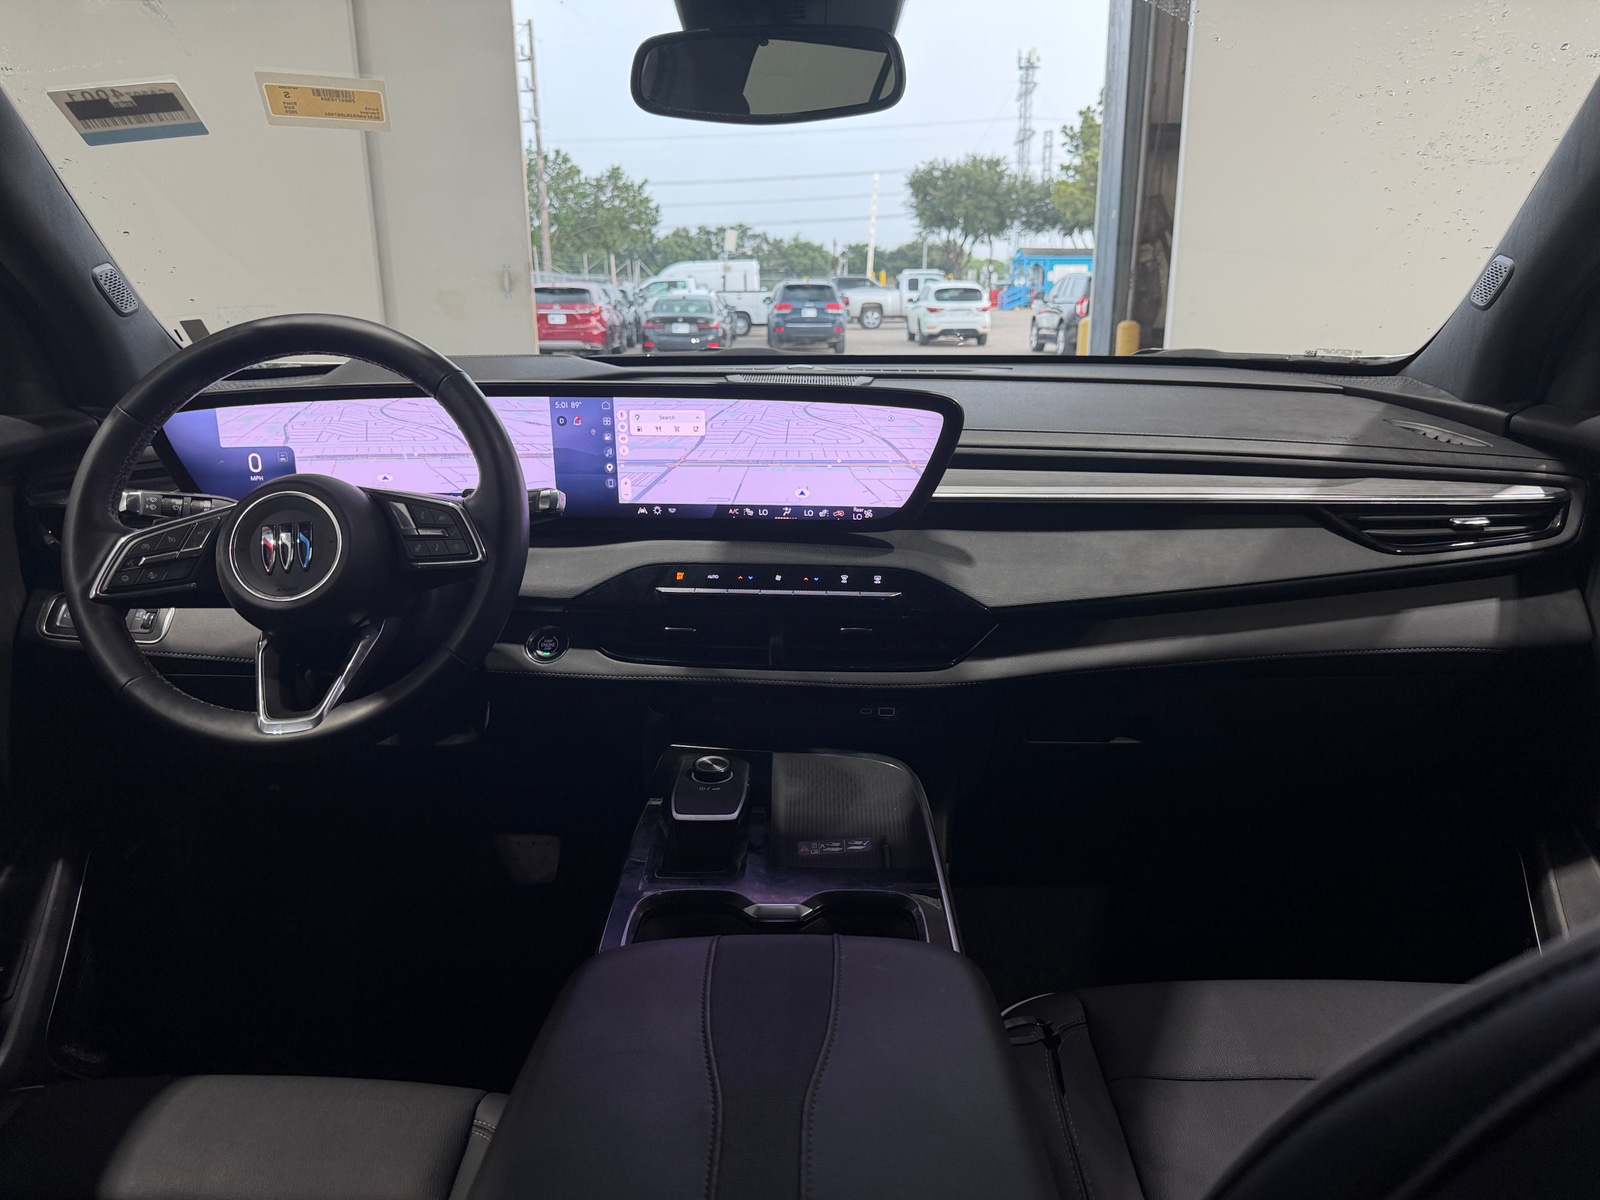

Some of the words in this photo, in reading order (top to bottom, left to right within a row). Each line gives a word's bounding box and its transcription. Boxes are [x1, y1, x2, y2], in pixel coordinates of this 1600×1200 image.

[555, 401, 568, 409] 5:01
[248, 453, 262, 473] 0
[803, 509, 814, 517] LO
[852, 513, 863, 521] LO
